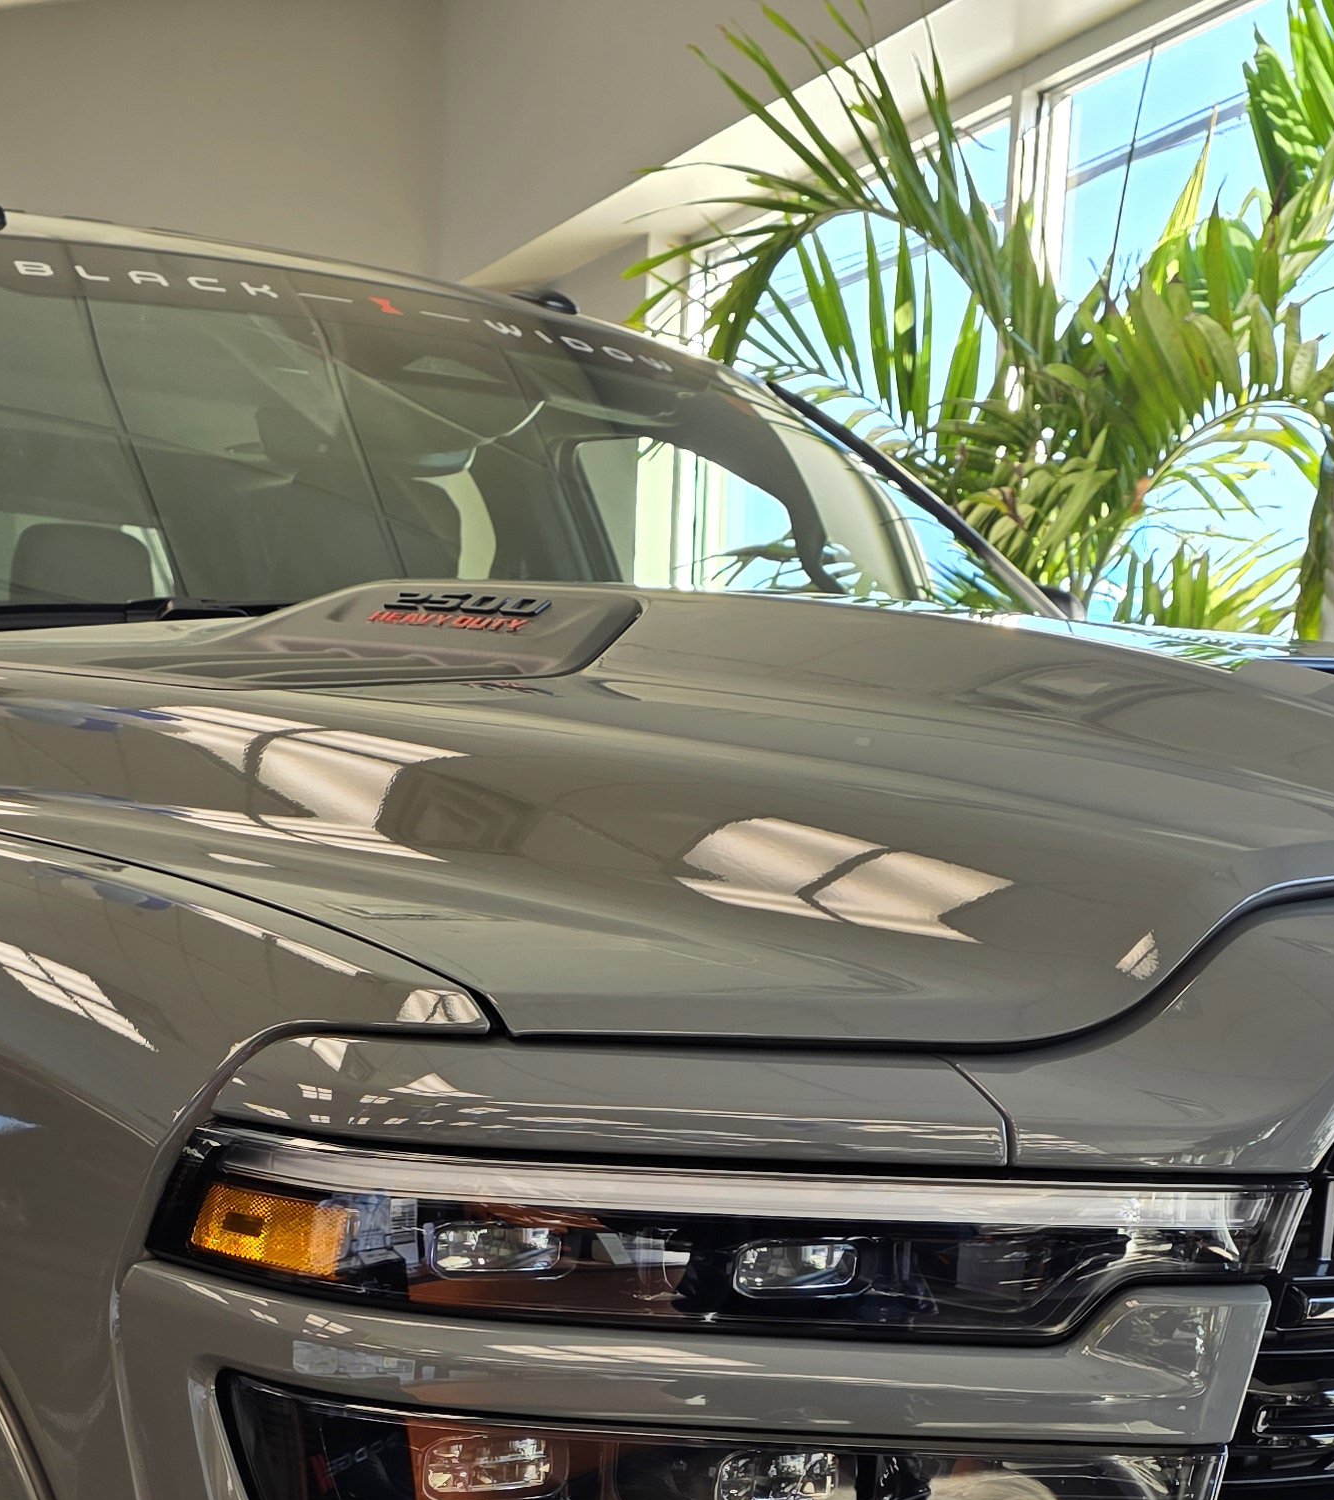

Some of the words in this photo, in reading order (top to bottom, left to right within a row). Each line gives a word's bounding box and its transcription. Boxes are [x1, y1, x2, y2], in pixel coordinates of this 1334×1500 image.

[13, 260, 279, 299] BLACK
[483, 318, 674, 373] WIDOW
[367, 611, 454, 627] HEAVY
[450, 615, 531, 632] DUTY
